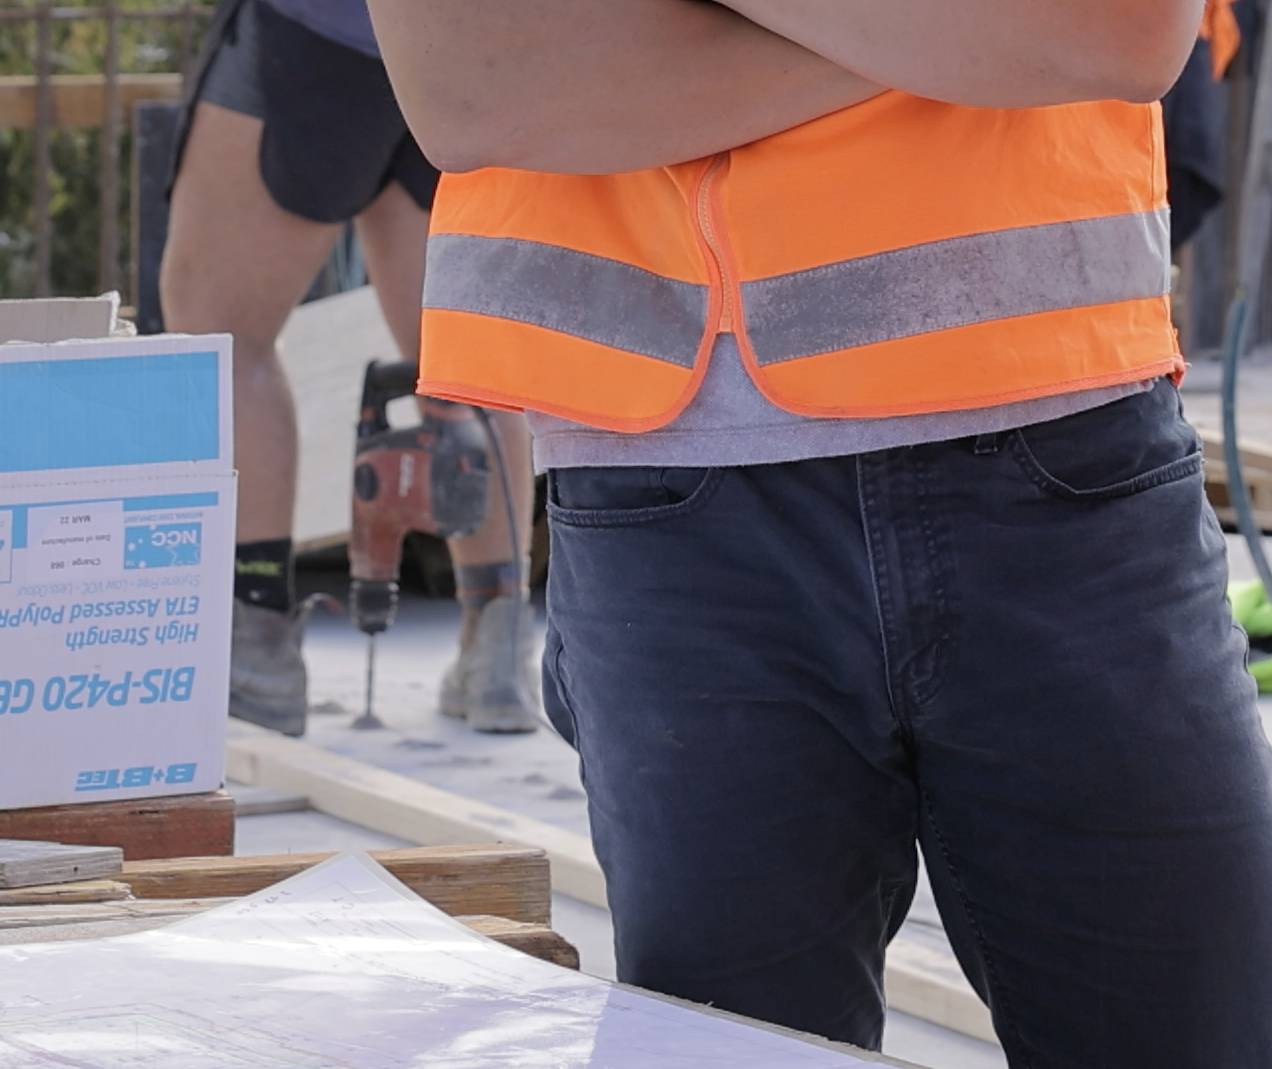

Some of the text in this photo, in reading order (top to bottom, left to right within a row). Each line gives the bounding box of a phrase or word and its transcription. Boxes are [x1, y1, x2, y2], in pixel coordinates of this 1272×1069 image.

[72, 515, 91, 524] MAR
[151, 530, 197, 546] NCC
[72, 557, 101, 568] Charge
[48, 582, 73, 595] Less
[81, 581, 104, 594] VOC
[159, 574, 200, 588] Styrene
[70, 598, 160, 623] Assessed
[166, 596, 200, 615] ETA
[66, 620, 199, 651] High Strength
[42, 666, 196, 712] BIS-P420
